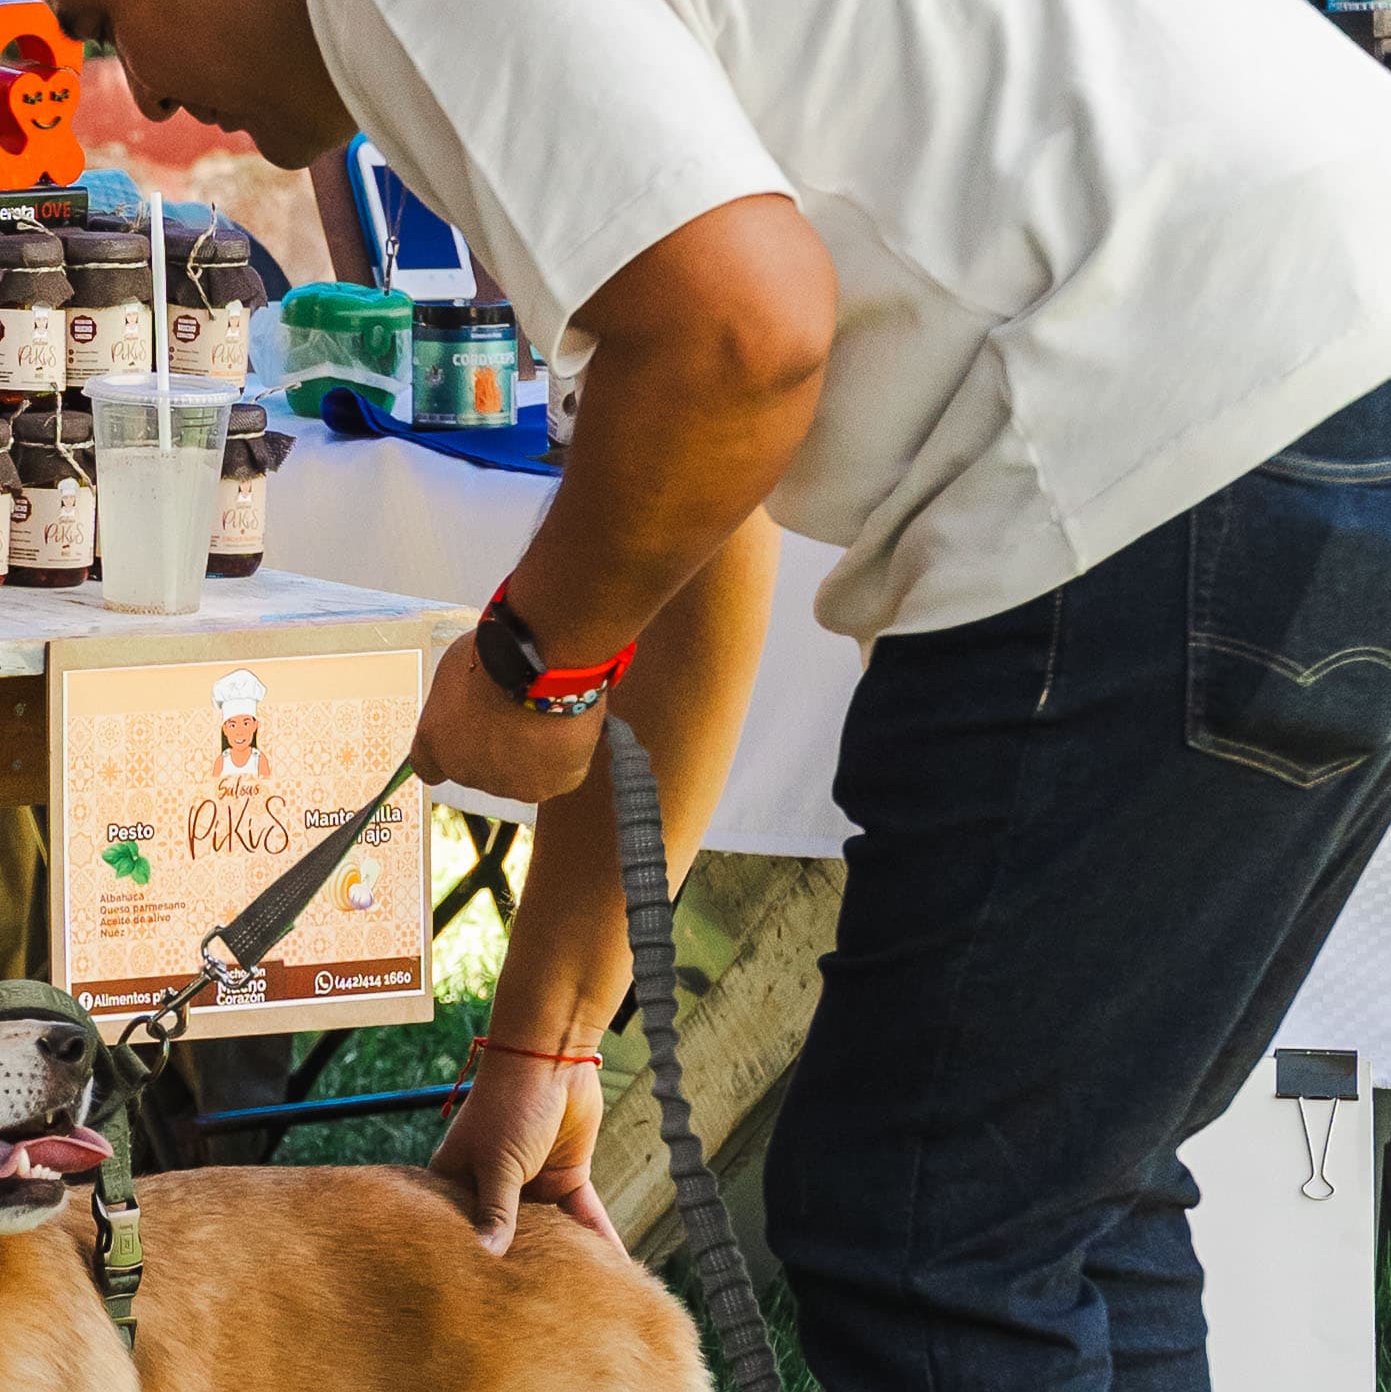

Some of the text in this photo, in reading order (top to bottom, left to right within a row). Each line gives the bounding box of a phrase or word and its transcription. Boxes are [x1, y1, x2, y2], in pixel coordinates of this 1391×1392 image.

[217, 778, 260, 800] Salsas
[108, 820, 154, 842] Pesto
[100, 892, 145, 902] Albahaca
[100, 902, 186, 915] Queso parmesano
[100, 915, 131, 926] Aceite
[133, 914, 146, 924] de
[93, 991, 151, 1008] Alimentos
[216, 991, 266, 1006] Corazón
